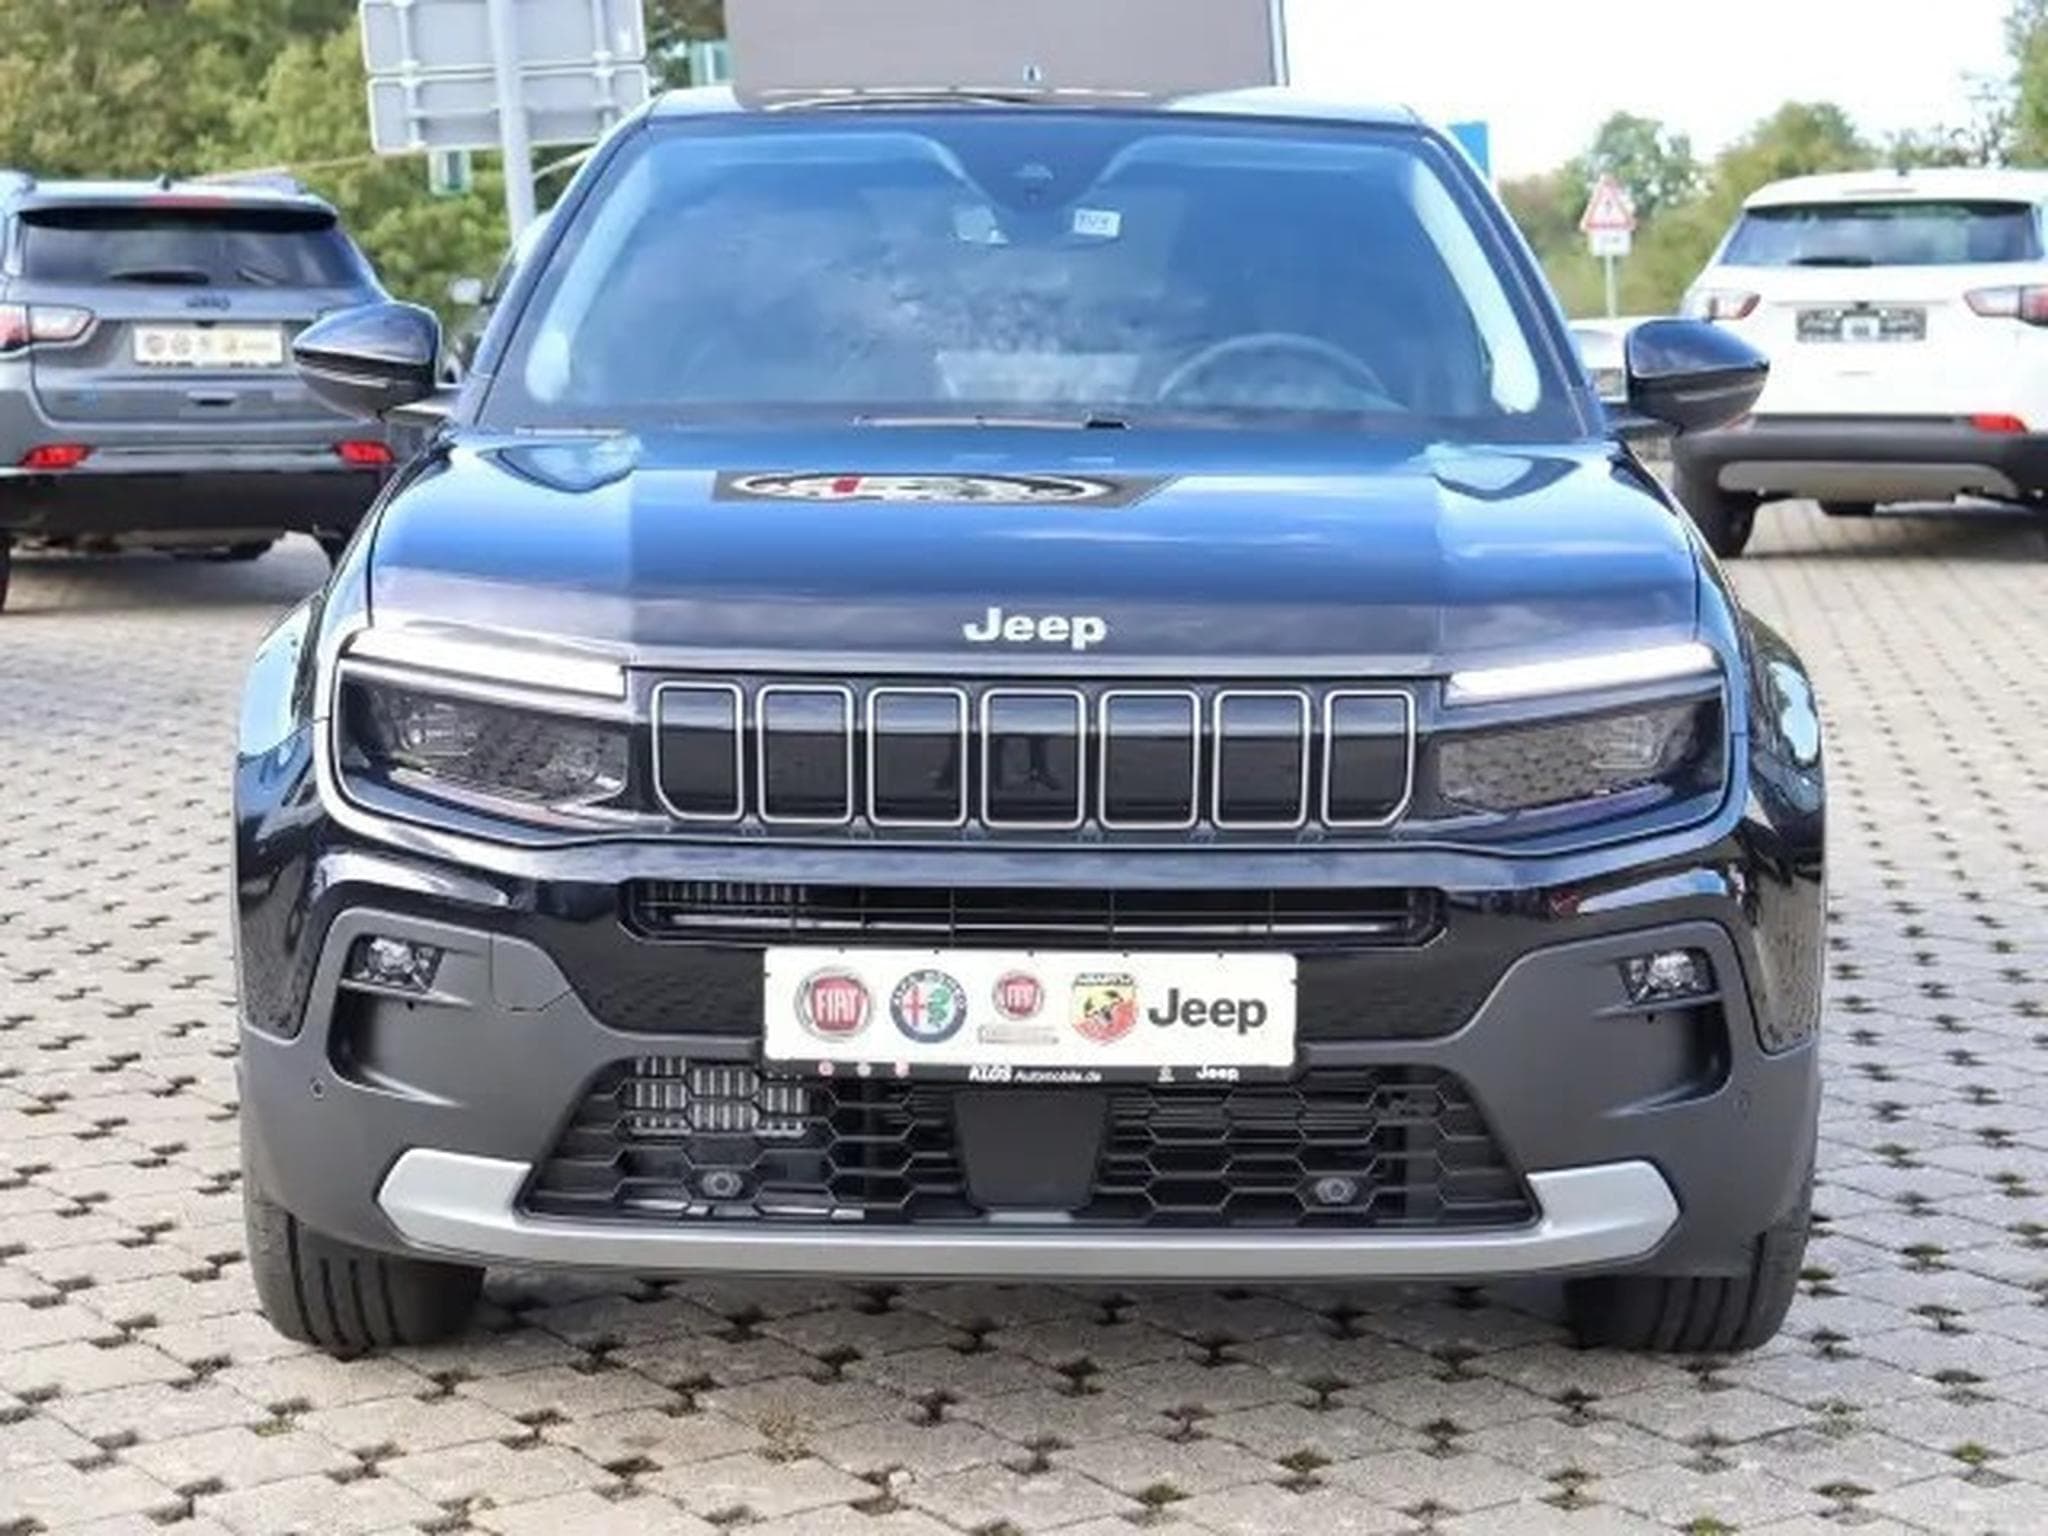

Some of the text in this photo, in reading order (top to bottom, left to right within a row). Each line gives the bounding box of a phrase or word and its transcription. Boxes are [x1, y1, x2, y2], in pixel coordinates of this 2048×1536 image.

[962, 607, 1107, 651] Jeep
[815, 989, 859, 1022] FIAT
[1148, 988, 1268, 1035] Jeep
[1196, 1063, 1240, 1082] Jeep
